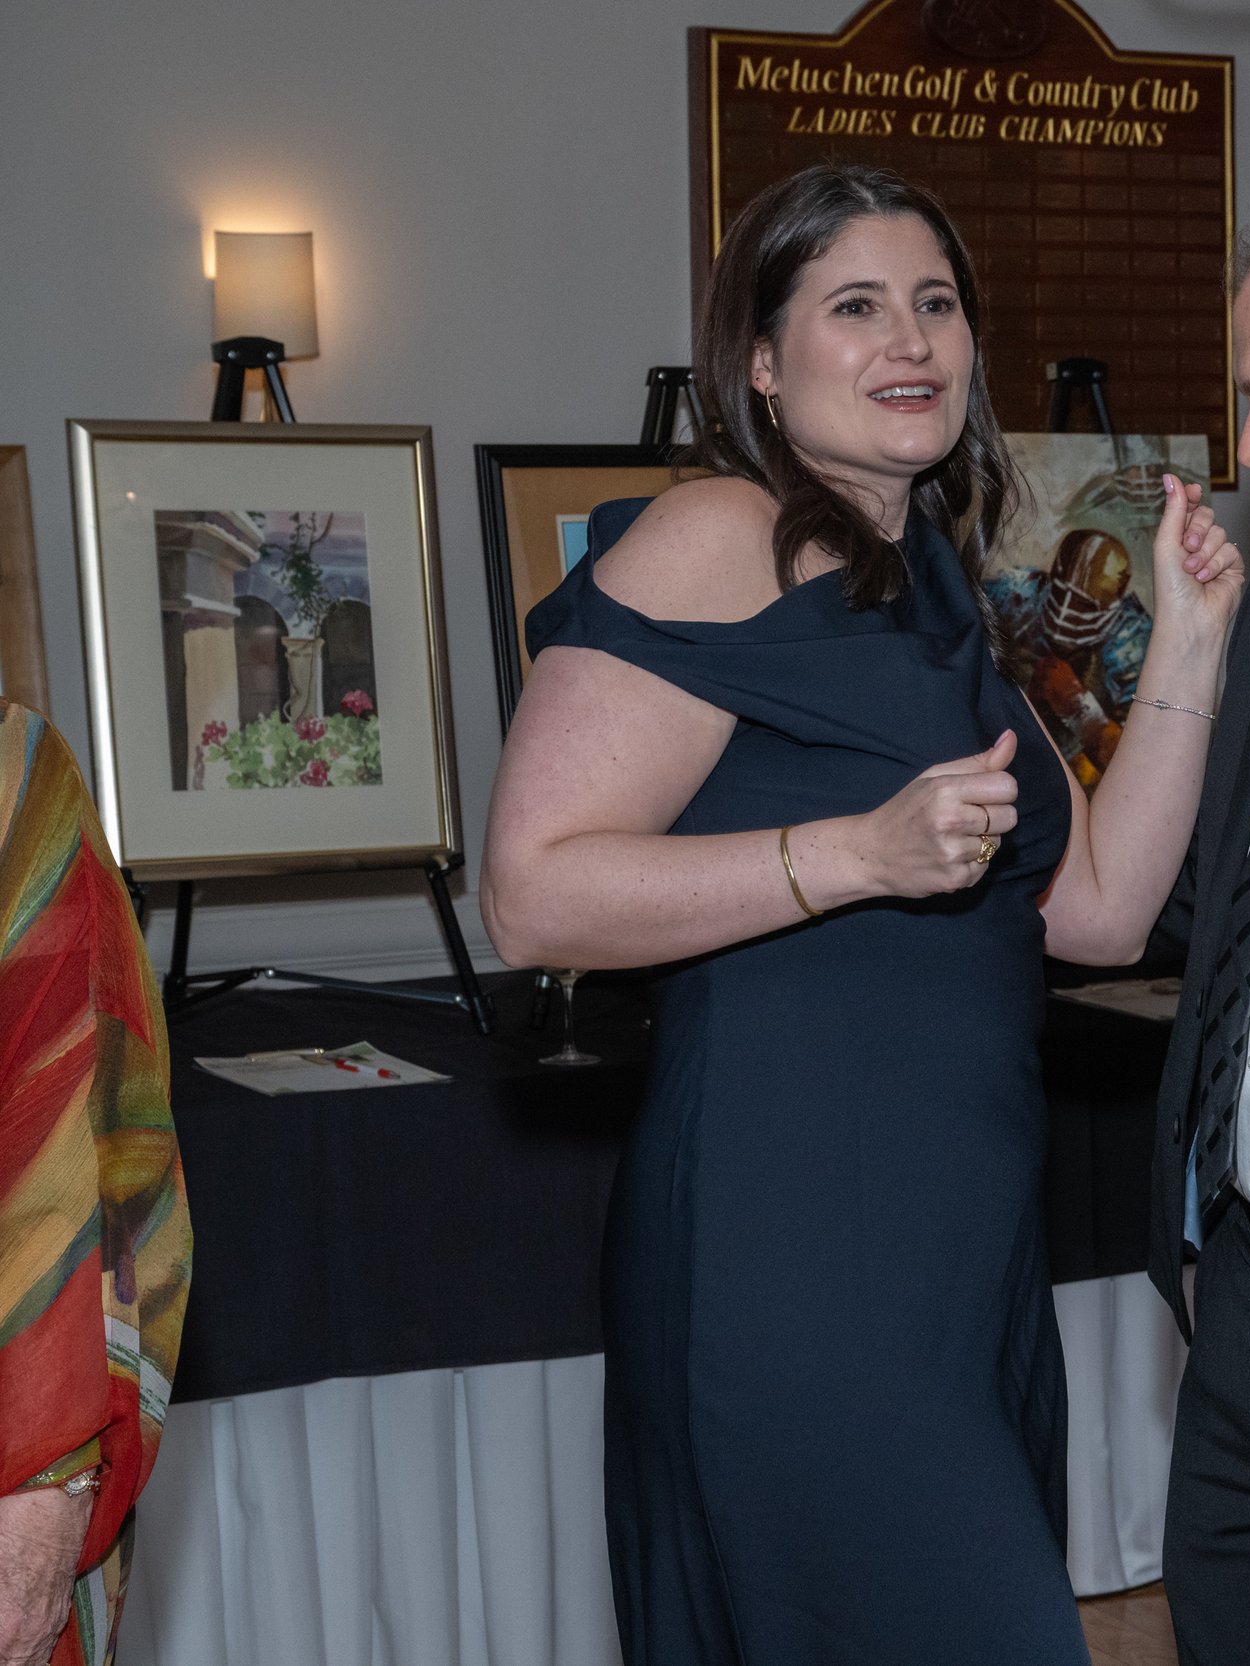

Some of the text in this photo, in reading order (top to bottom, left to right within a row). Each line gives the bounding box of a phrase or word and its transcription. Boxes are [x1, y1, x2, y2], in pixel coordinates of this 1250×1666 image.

[903, 64, 969, 110] Golf
[973, 68, 999, 103] &
[1006, 71, 1126, 118] Country
[1130, 77, 1199, 114] Club
[786, 106, 1168, 147] LADIES CLUB CHAMPIONS
